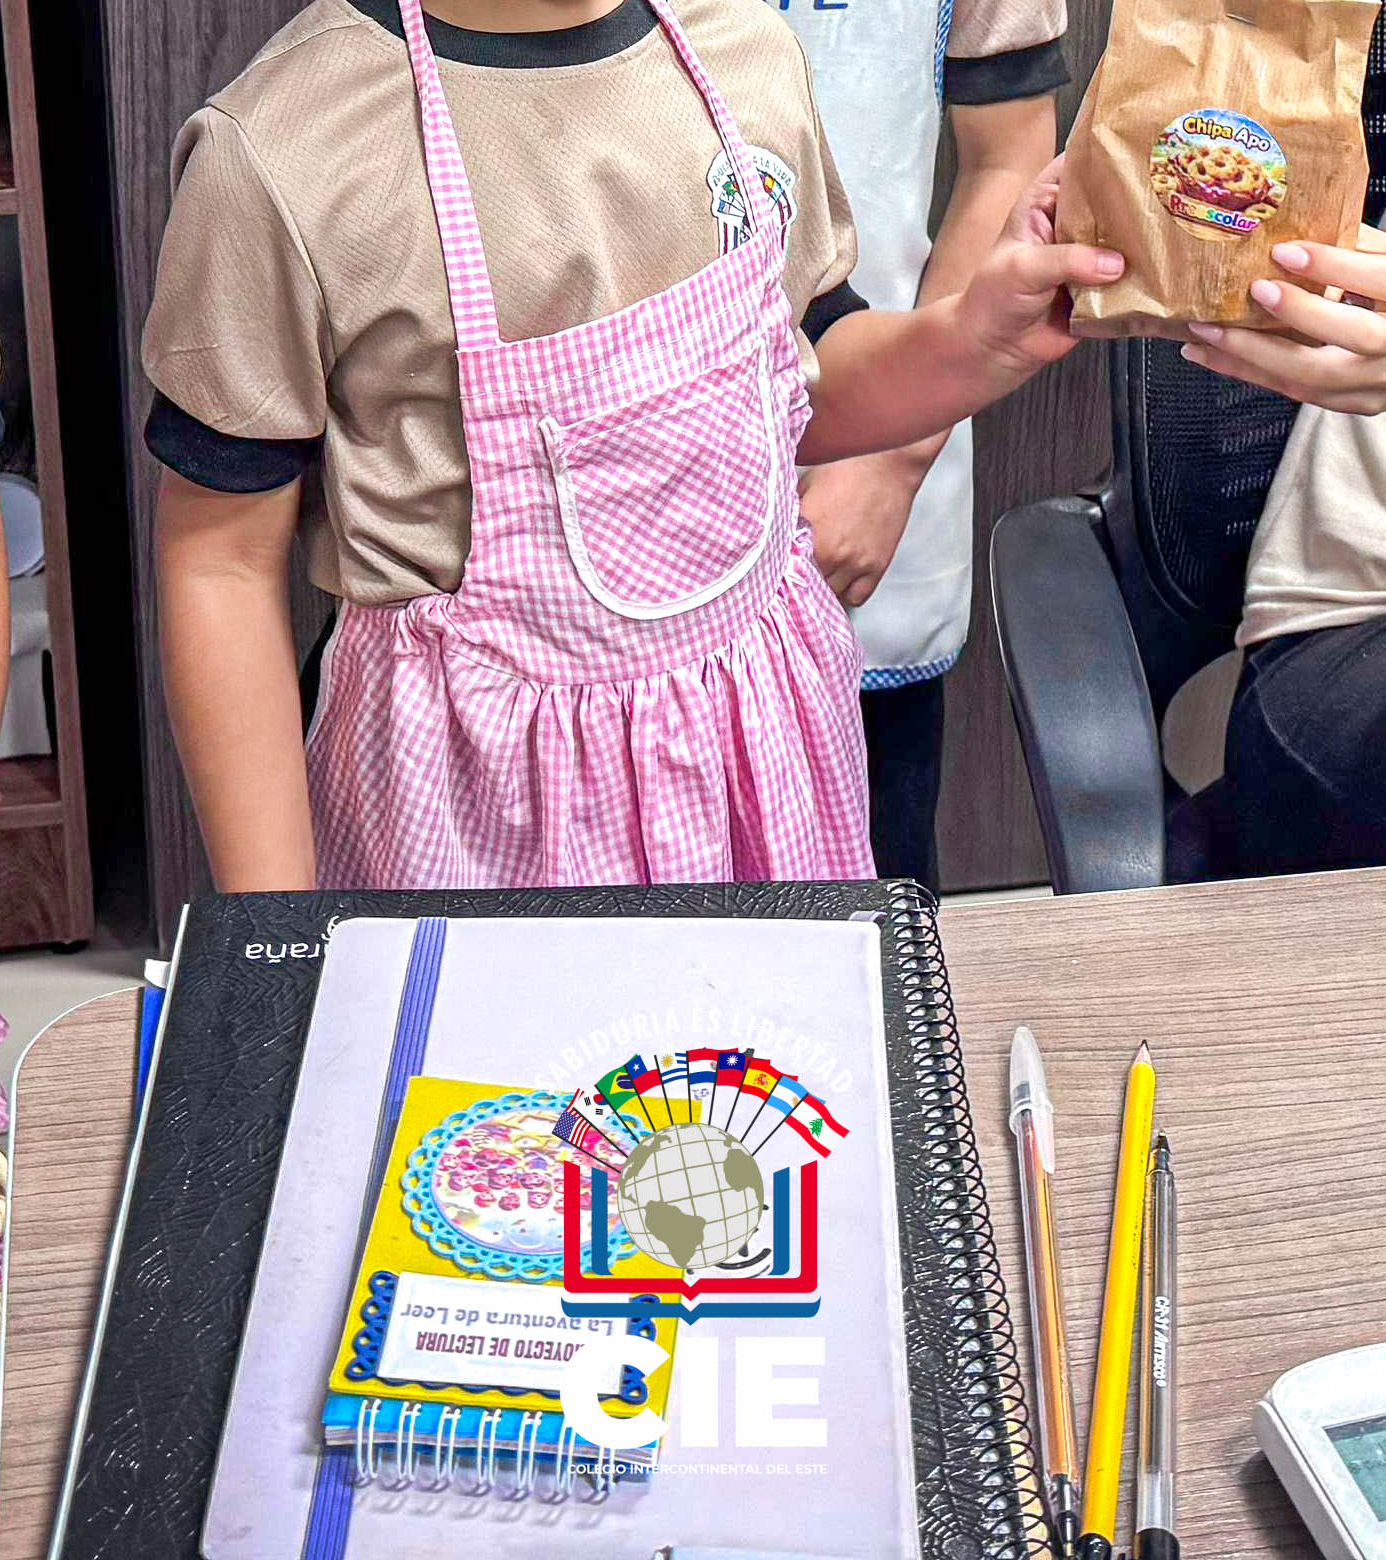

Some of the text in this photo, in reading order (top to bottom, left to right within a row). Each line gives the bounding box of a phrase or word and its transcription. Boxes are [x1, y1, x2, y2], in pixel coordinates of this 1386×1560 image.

[1183, 117, 1272, 153] Chipa Apo
[245, 942, 320, 964] raña
[400, 1301, 613, 1335] La aventura de Leer
[415, 1330, 586, 1362] OYECTO DE LECTURA
